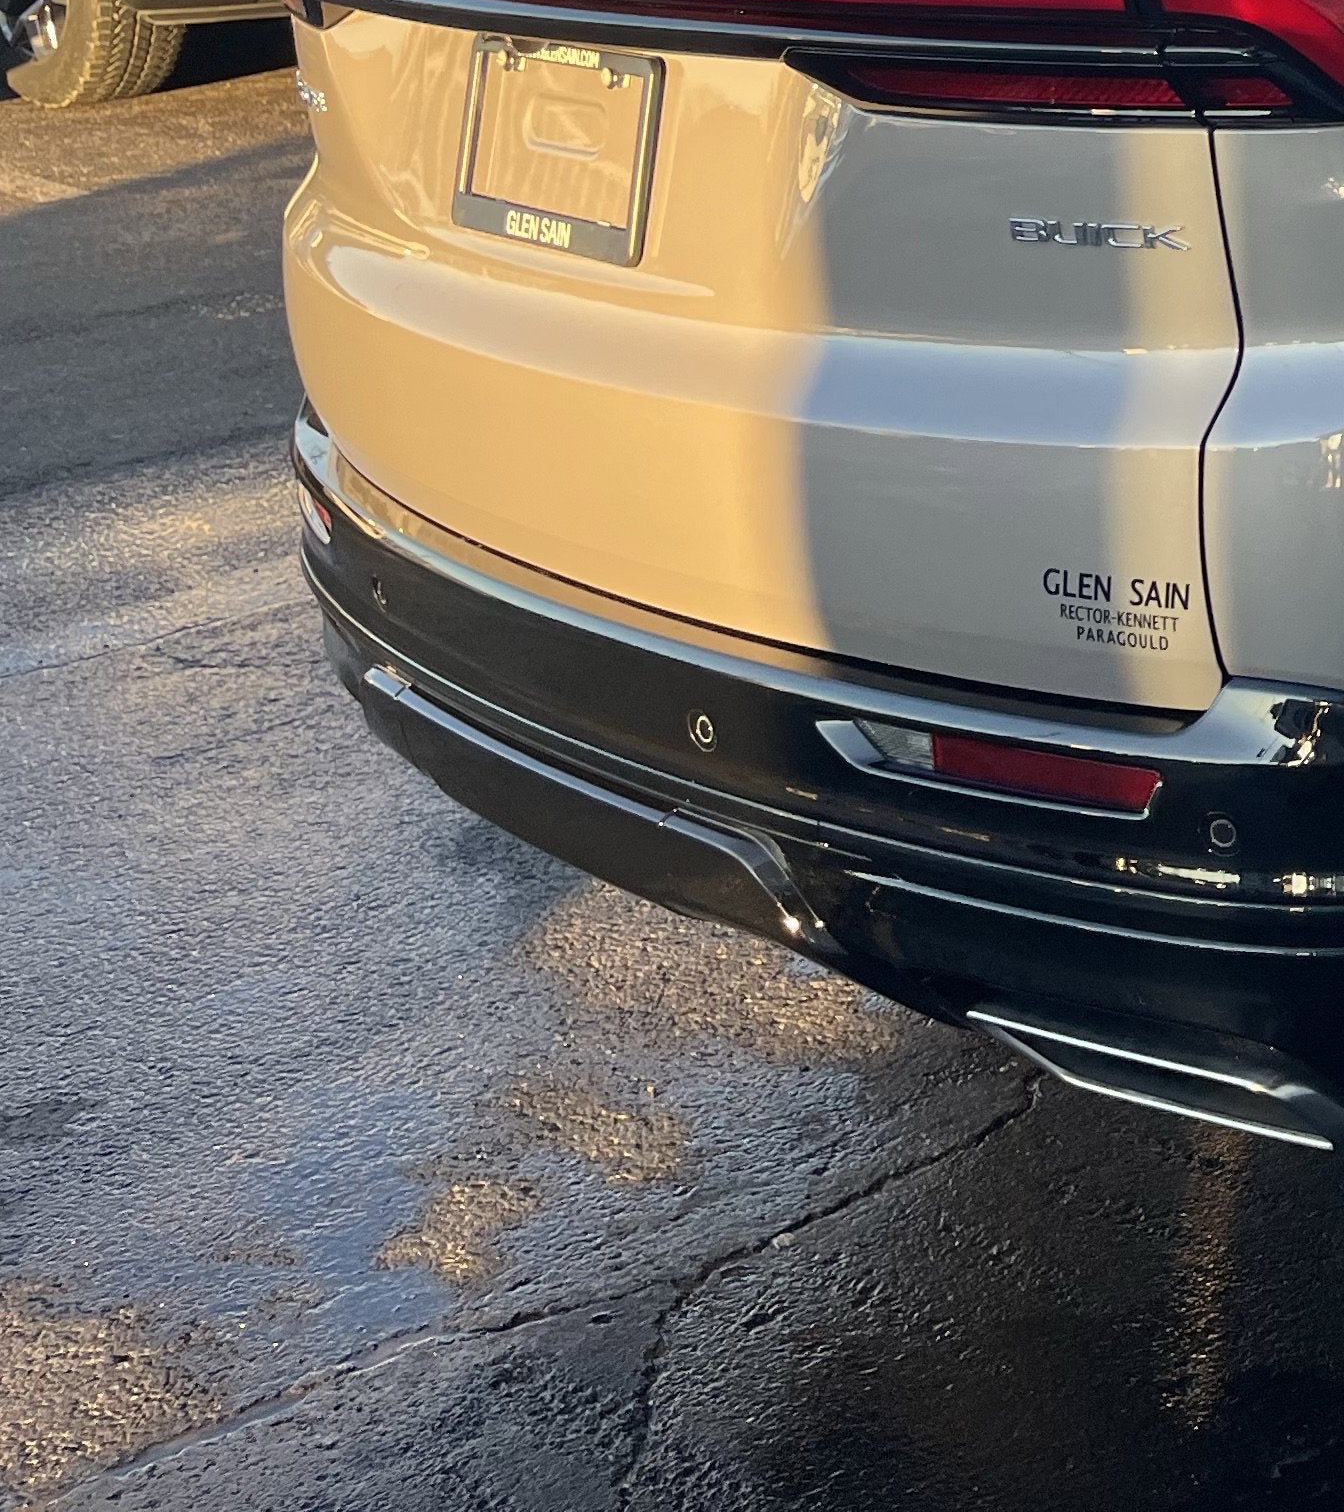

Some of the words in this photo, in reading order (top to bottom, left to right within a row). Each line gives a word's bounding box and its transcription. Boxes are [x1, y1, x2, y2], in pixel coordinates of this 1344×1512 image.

[506, 209, 540, 240] GLEN
[540, 217, 571, 248] SAIN
[1009, 217, 1191, 251] BUICK
[1043, 567, 1112, 602] GLEN
[1129, 578, 1190, 610] SAIN
[1060, 603, 1179, 632] RECTOR-KENNETT
[1076, 625, 1169, 651] PARAGOULD
